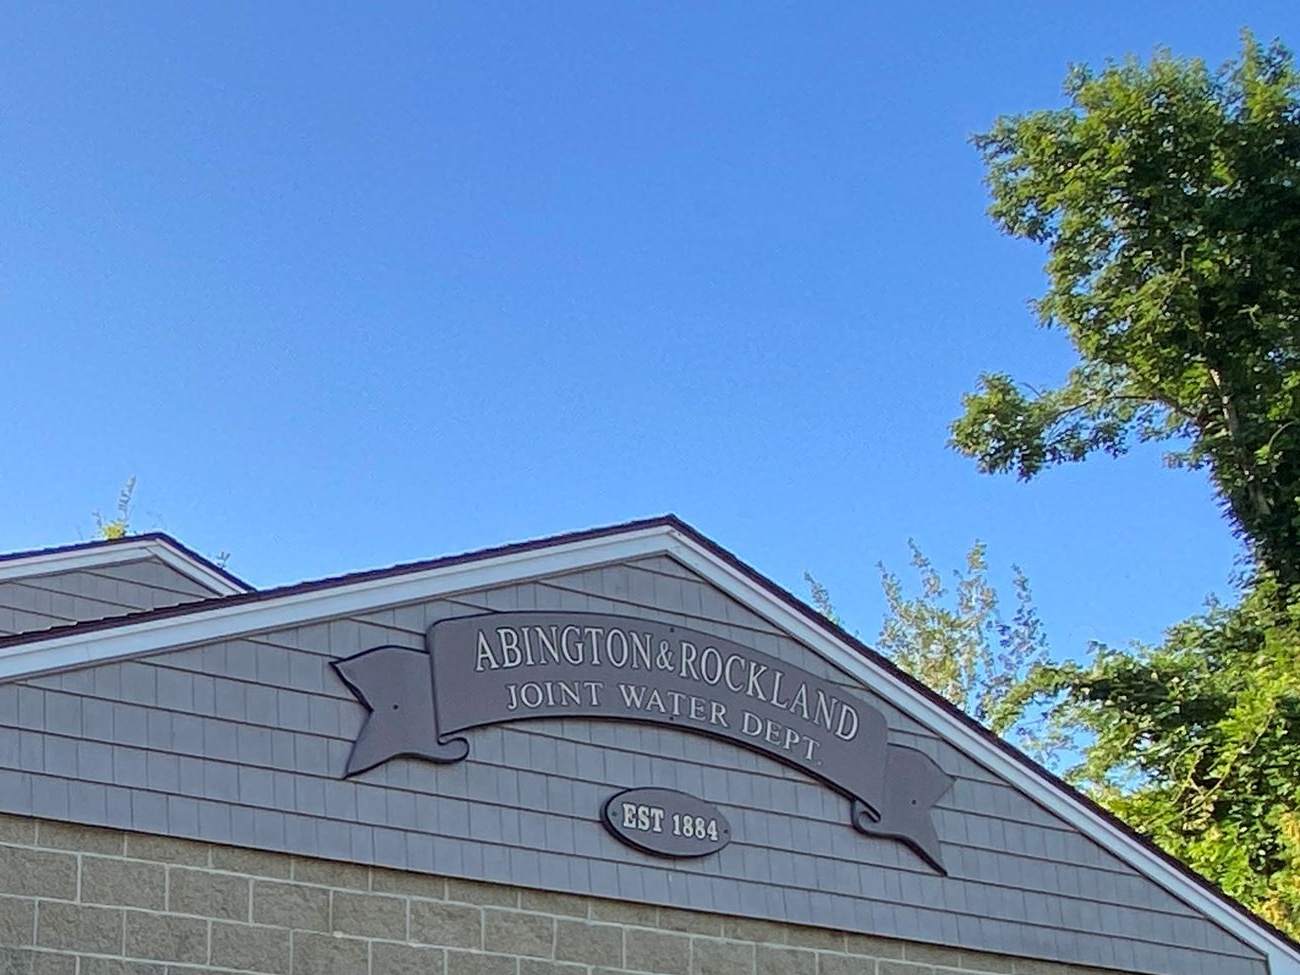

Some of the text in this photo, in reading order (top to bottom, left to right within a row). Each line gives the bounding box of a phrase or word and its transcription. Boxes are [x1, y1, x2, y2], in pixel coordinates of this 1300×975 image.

[506, 681, 823, 767] JOINT WATER DEPT.
[622, 803, 719, 841] EST 1884
